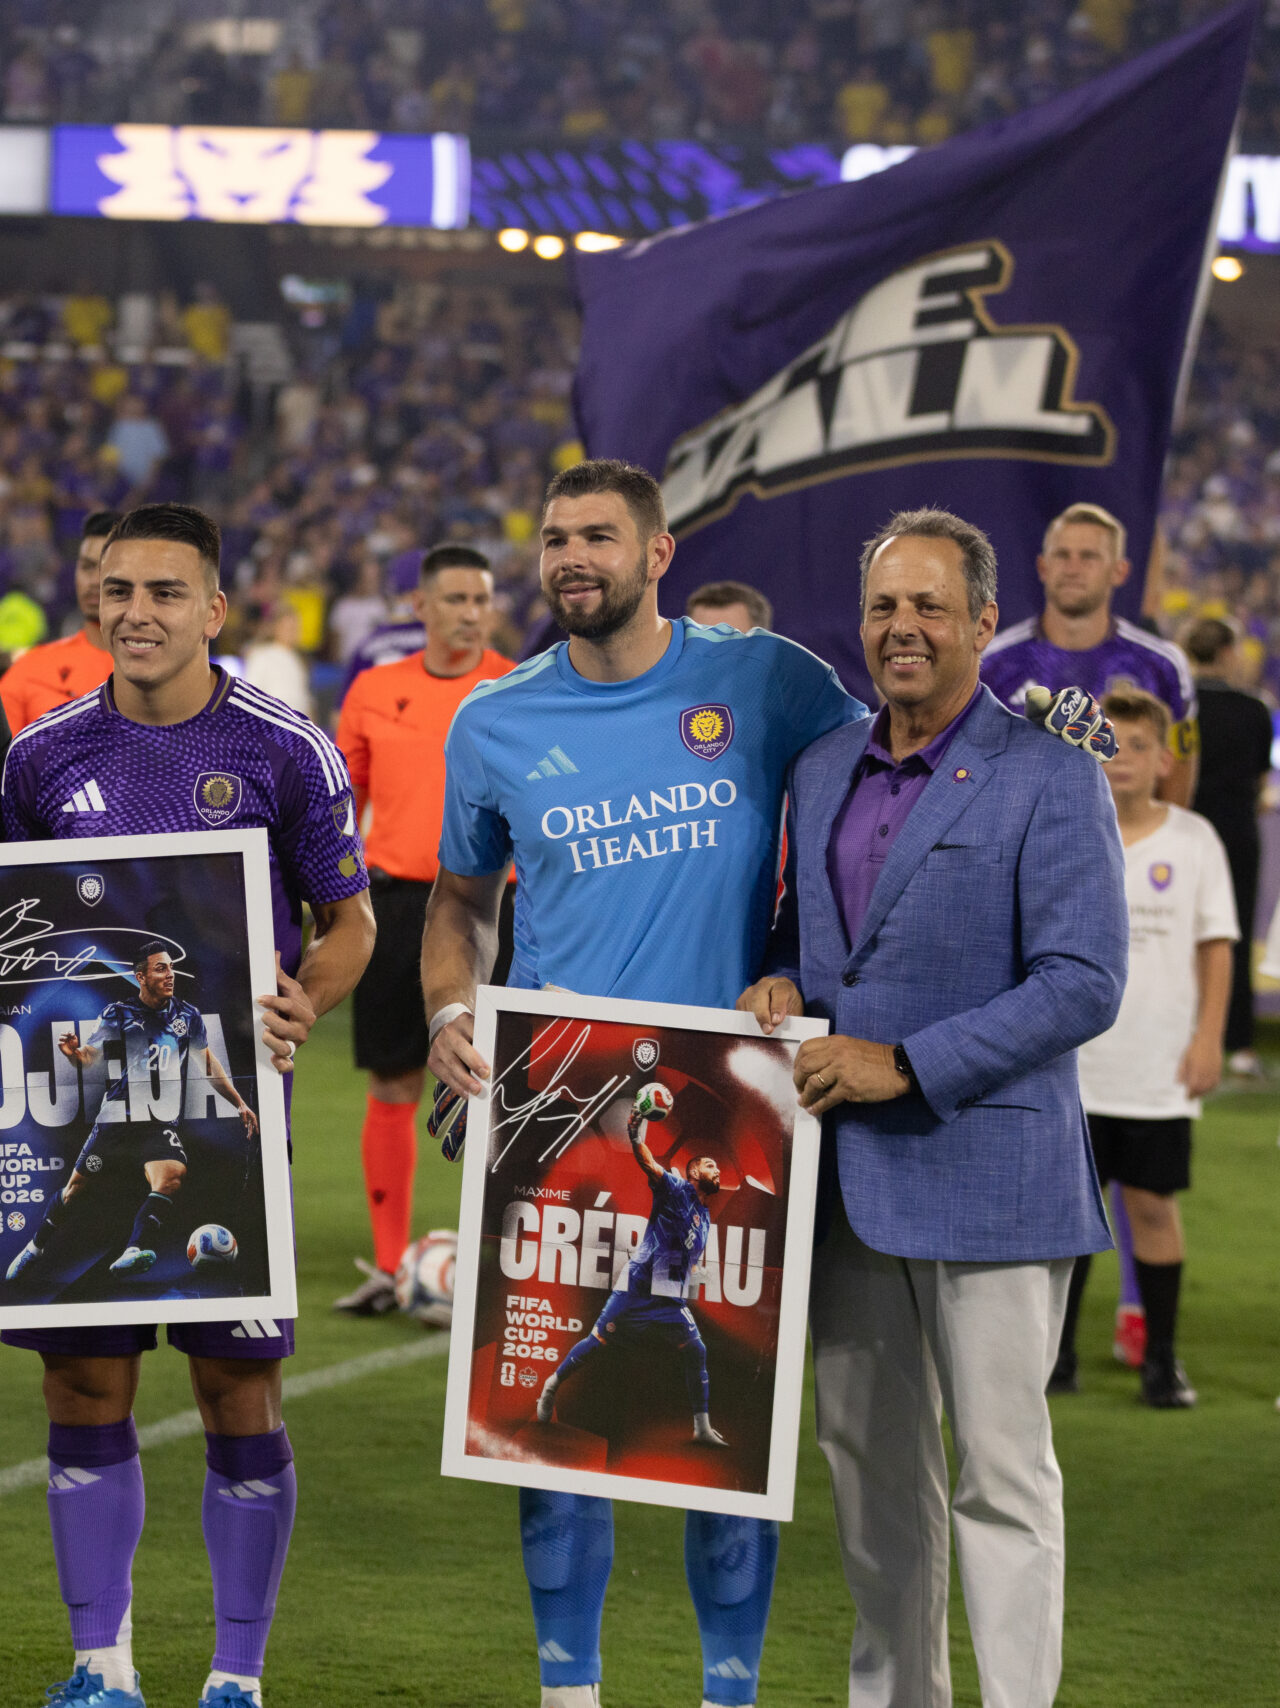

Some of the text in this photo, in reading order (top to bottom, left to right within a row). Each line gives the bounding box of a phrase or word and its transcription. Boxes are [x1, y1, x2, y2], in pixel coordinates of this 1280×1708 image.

[694, 741, 725, 750] ORLANDO
[200, 807, 230, 816] ORLANDO
[541, 778, 737, 839] ORLANDO
[567, 819, 719, 873] HEALTH
[146, 1043, 172, 1072] 20
[514, 1185, 571, 1201] MAXIME
[506, 1294, 553, 1313] FIFA
[505, 1310, 583, 1332] WORLD
[504, 1326, 548, 1344] CUP
[502, 1342, 559, 1362] 2026
